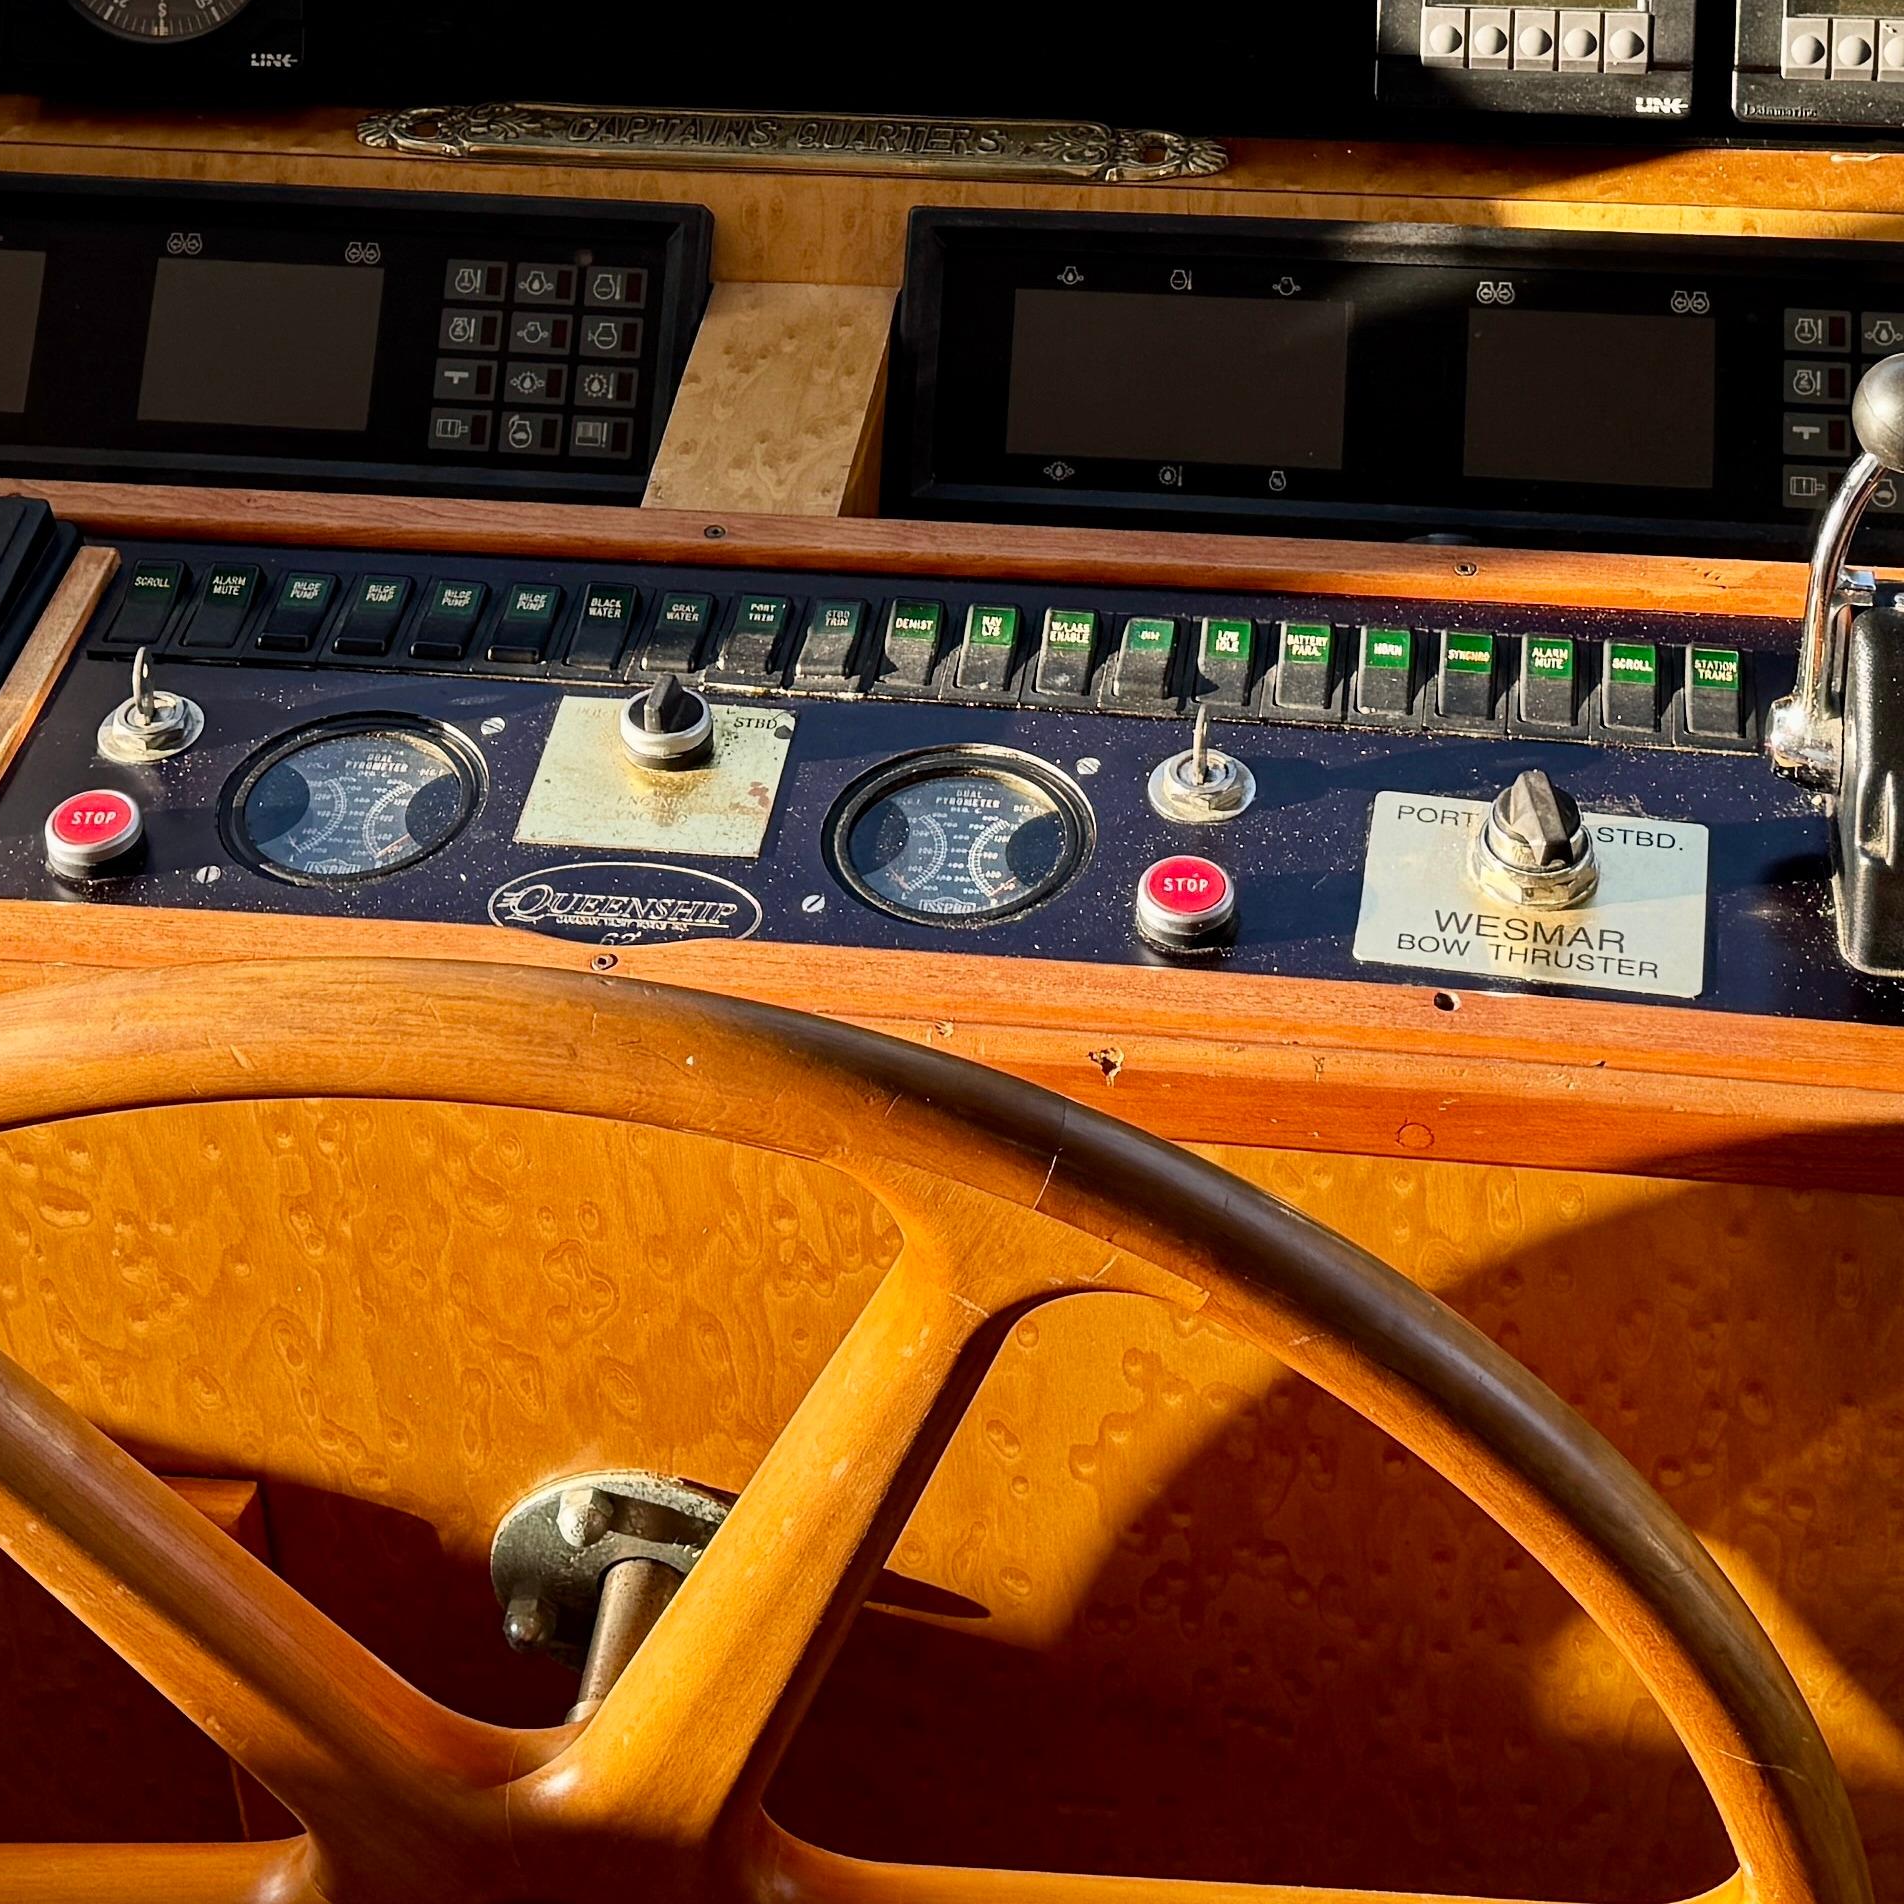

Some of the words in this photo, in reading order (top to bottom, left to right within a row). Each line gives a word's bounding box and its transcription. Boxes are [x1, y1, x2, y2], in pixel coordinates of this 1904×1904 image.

[157, 2, 168, 18] S
[250, 52, 298, 68] LINK
[1635, 96, 1689, 115] LINK
[568, 116, 779, 147] CAPTAINS
[796, 121, 1003, 156] QUARTERS
[134, 576, 171, 589] SCROLL
[212, 576, 247, 587] ALARM
[213, 585, 241, 597] MUTE
[590, 597, 623, 609] BLACK
[588, 607, 622, 619] WATER
[665, 611, 700, 623] WATER
[896, 617, 934, 630] DEMIST
[1050, 631, 1090, 644] ENABLE
[1217, 629, 1240, 641] LOW
[1286, 635, 1329, 646] BATTERY
[1531, 647, 1569, 660] ALARM
[1534, 658, 1565, 670] MUTE
[1612, 658, 1653, 673] SCROLL
[1694, 659, 1737, 672] STATION
[1696, 670, 1733, 683] TRANS
[733, 716, 778, 731] STBD
[345, 760, 410, 773] PYROMETER
[956, 789, 983, 798] DUAL
[935, 797, 1001, 809] PYROMETER
[71, 810, 117, 825] STOP
[1397, 804, 1480, 828] PORT
[1597, 826, 1685, 852] STBD.
[1163, 877, 1210, 892] STOP
[498, 884, 738, 924] QUEENSHIP
[1434, 909, 1626, 954] WESMAR
[1397, 933, 1470, 957] BOW
[1489, 944, 1659, 980] THRUSTER
